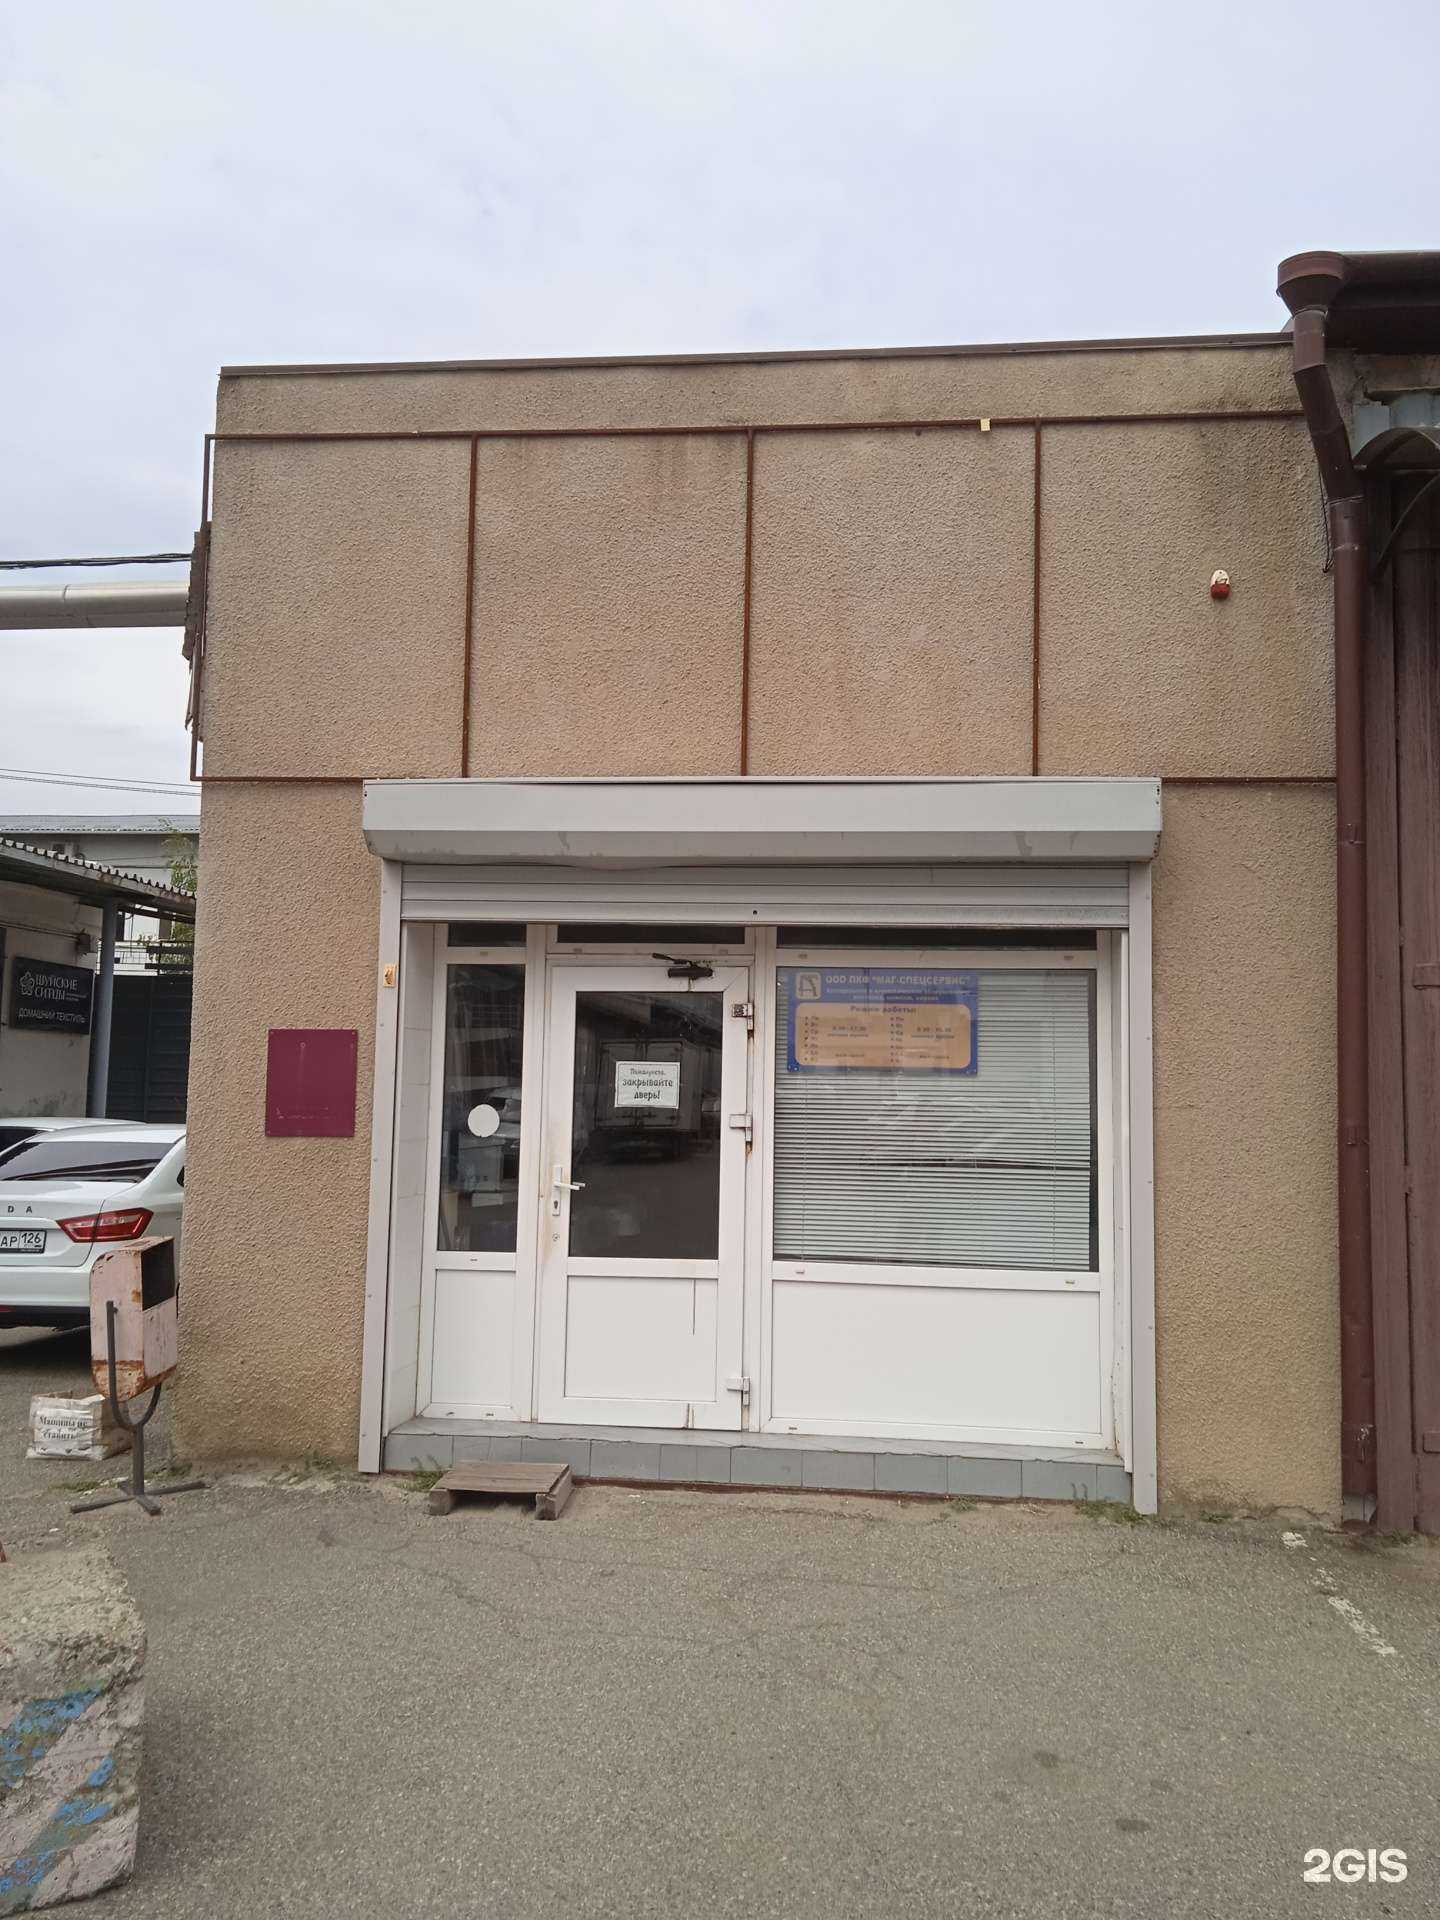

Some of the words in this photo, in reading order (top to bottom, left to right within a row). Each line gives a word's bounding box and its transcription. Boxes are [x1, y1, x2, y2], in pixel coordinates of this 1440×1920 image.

[825, 975, 846, 985] ООО
[622, 1079, 673, 1088] закрывайте
[634, 1090, 660, 1101] дверь!
[40, 1416, 75, 1427] Машины
